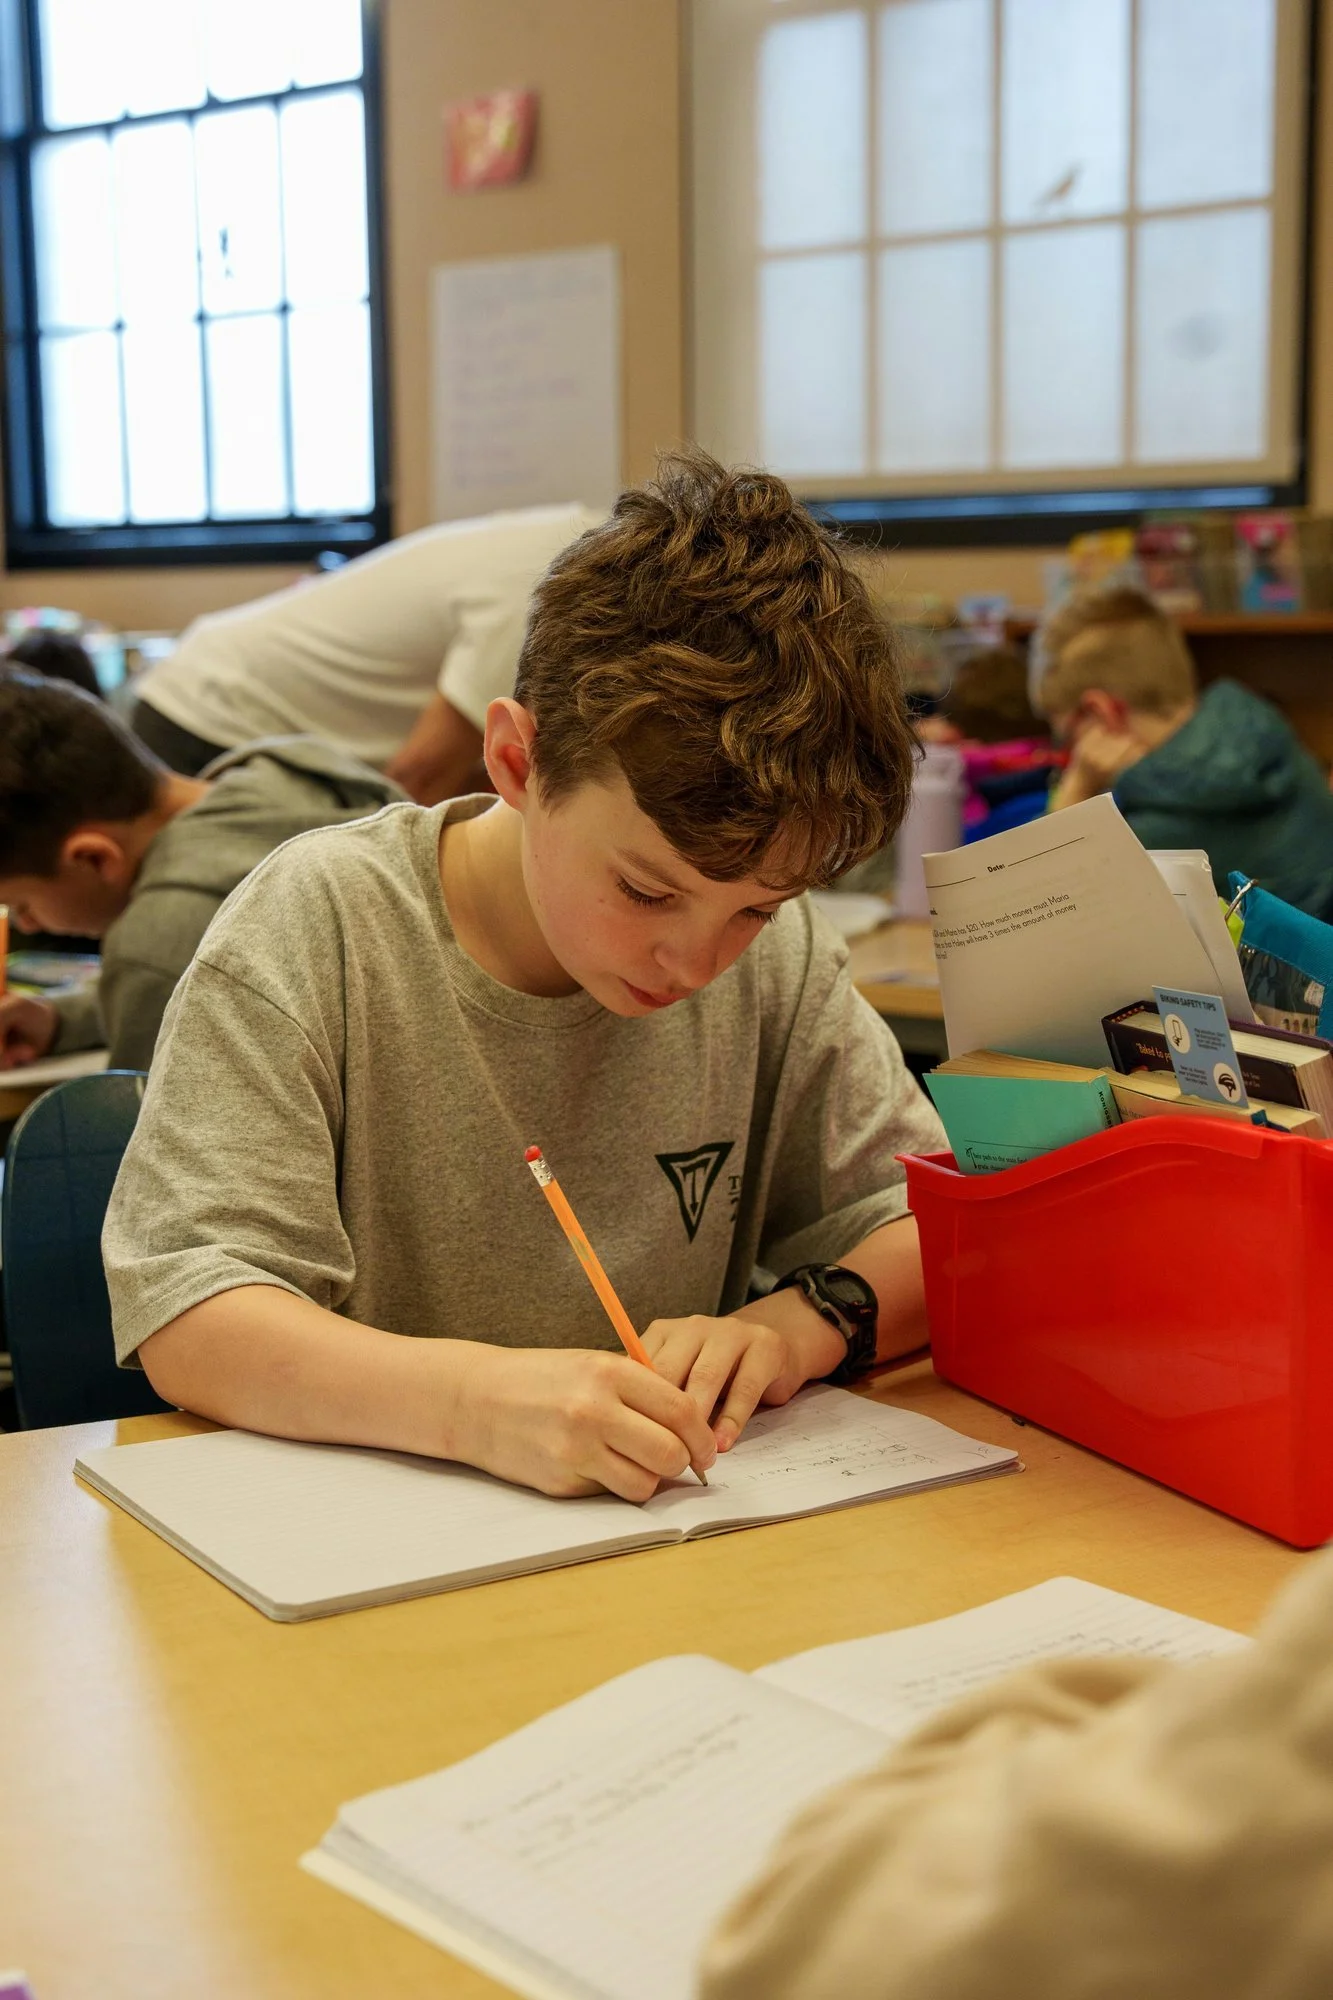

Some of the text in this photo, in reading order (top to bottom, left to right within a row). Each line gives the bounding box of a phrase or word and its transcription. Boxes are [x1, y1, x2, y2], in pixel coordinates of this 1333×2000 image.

[986, 863, 1006, 873] Date:
[979, 920, 995, 929] How
[995, 912, 1012, 924] much
[1011, 907, 1033, 919] money
[1033, 901, 1049, 911] must
[1047, 893, 1070, 905] Maria
[966, 935, 975, 945] will
[973, 934, 989, 943] have
[987, 930, 994, 939] 3
[994, 927, 1011, 937] times
[1010, 922, 1022, 931] the
[1022, 914, 1047, 928] amount
[1046, 909, 1054, 919] of
[1054, 903, 1077, 916] money
[1179, 997, 1202, 1009] SAFETY
[1202, 1001, 1217, 1012] TIPS
